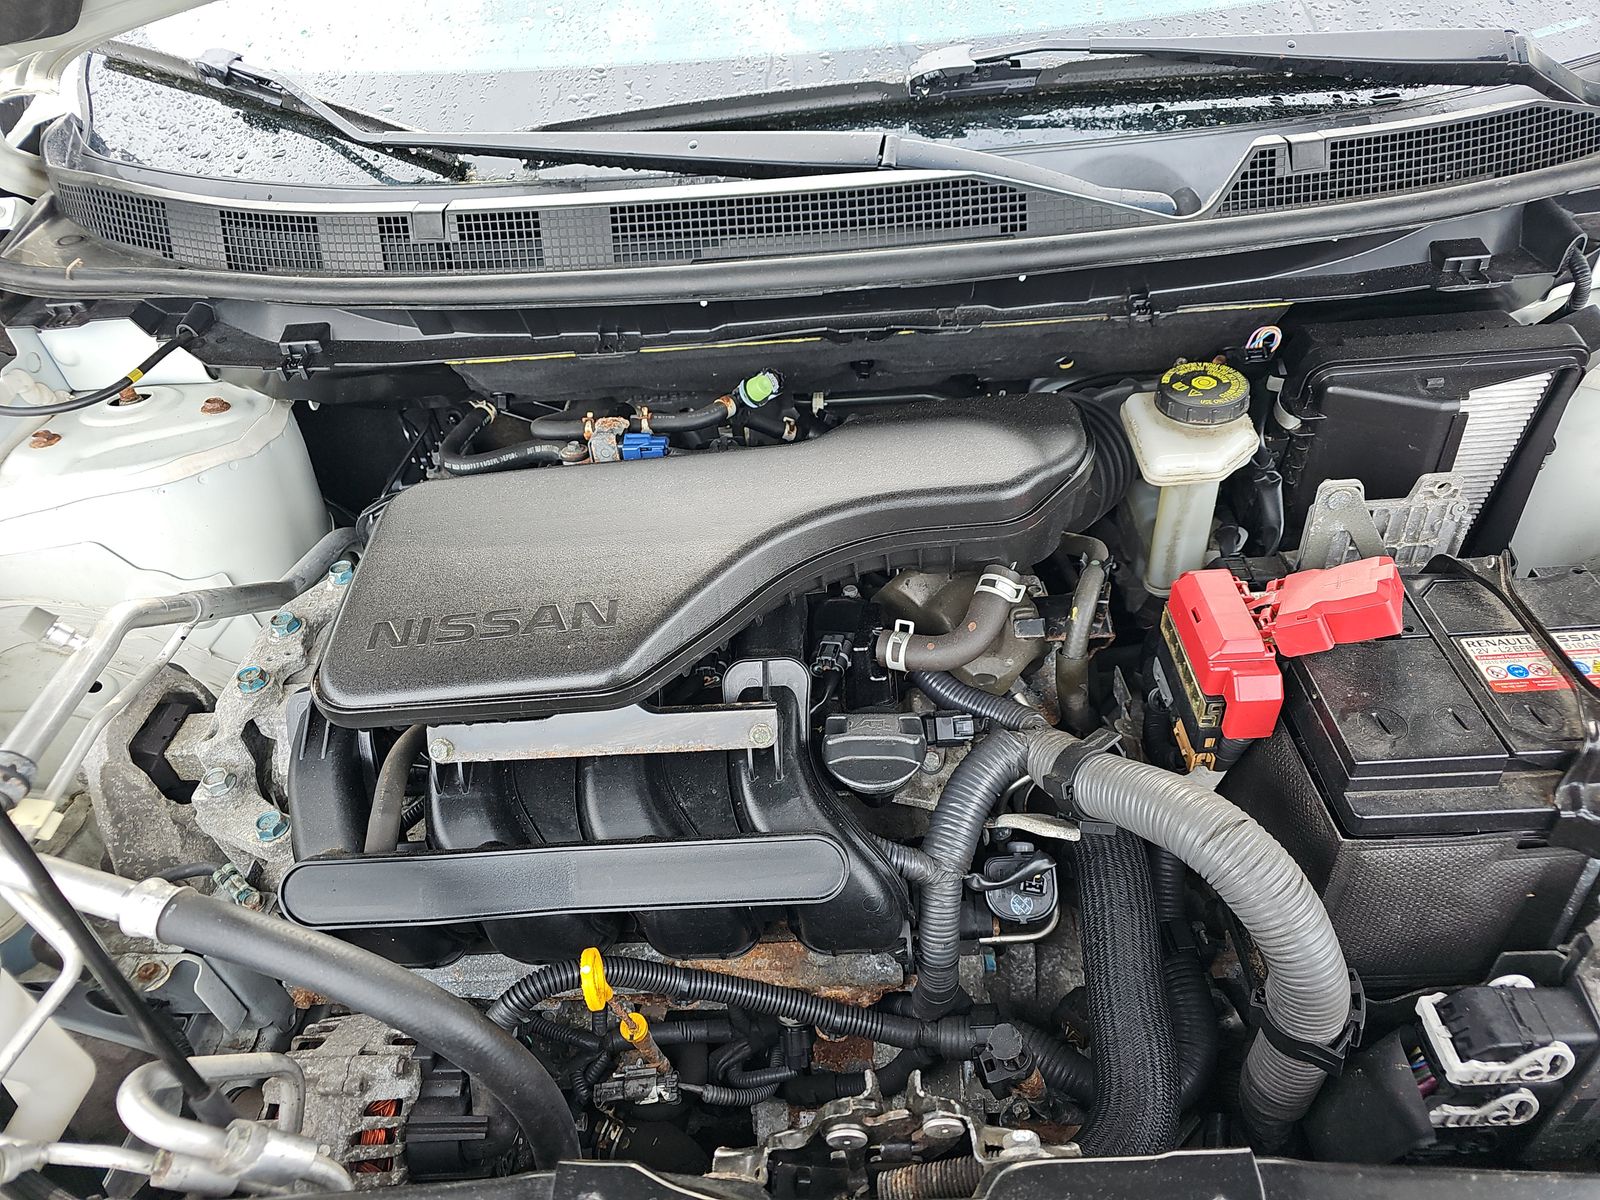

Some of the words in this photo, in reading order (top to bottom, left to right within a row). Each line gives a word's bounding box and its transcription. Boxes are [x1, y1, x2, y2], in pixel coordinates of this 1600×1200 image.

[366, 600, 619, 651] NISSAN
[1465, 637, 1532, 648] RENAULT
[1556, 633, 1600, 642] SSAN
[1470, 647, 1489, 655] 12V
